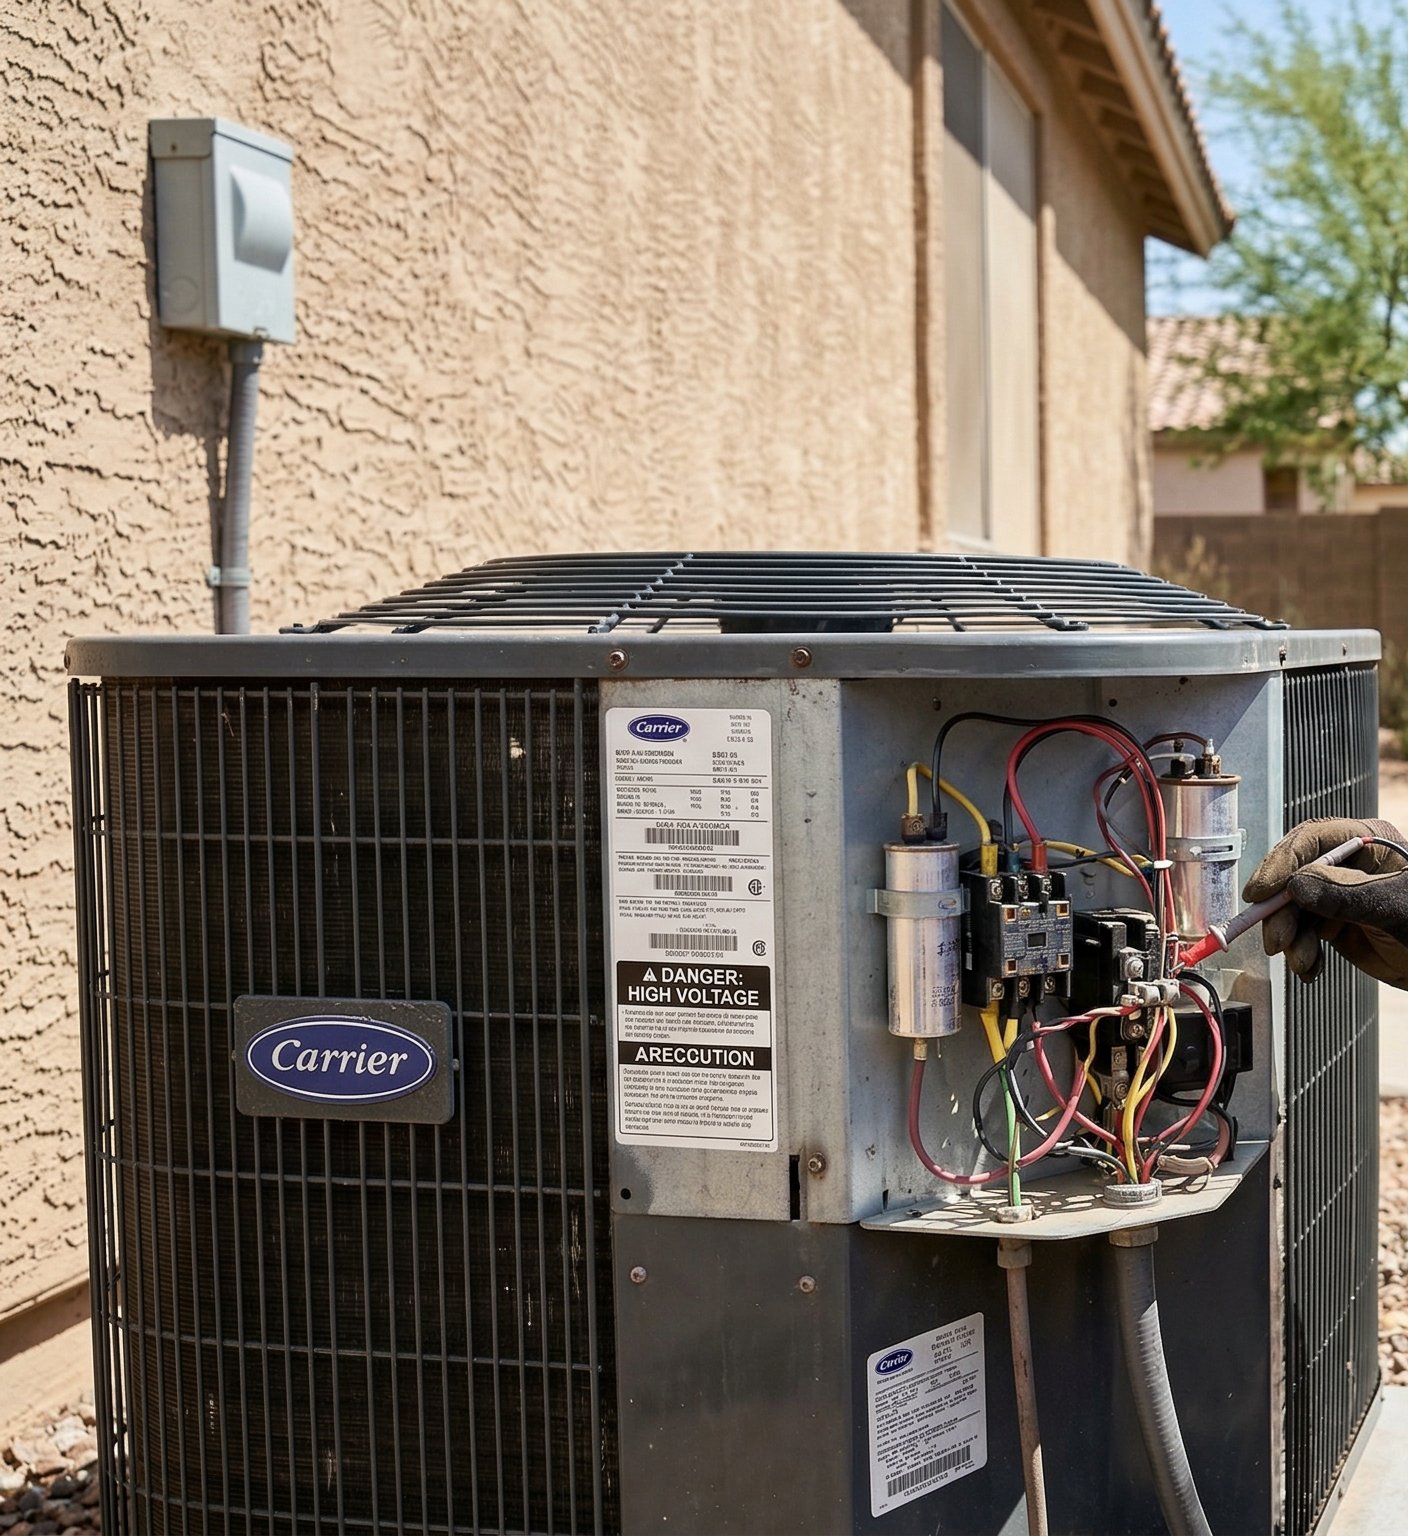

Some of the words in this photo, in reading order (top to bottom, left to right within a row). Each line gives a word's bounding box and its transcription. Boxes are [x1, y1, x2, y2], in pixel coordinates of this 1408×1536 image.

[635, 721, 682, 735] Carrier
[661, 967, 744, 986] DANGER:
[628, 986, 671, 1003] HIGH
[676, 987, 760, 1006] VOLTAGE
[271, 1039, 409, 1075] Carrier
[634, 1046, 755, 1067] ARECCUTION
